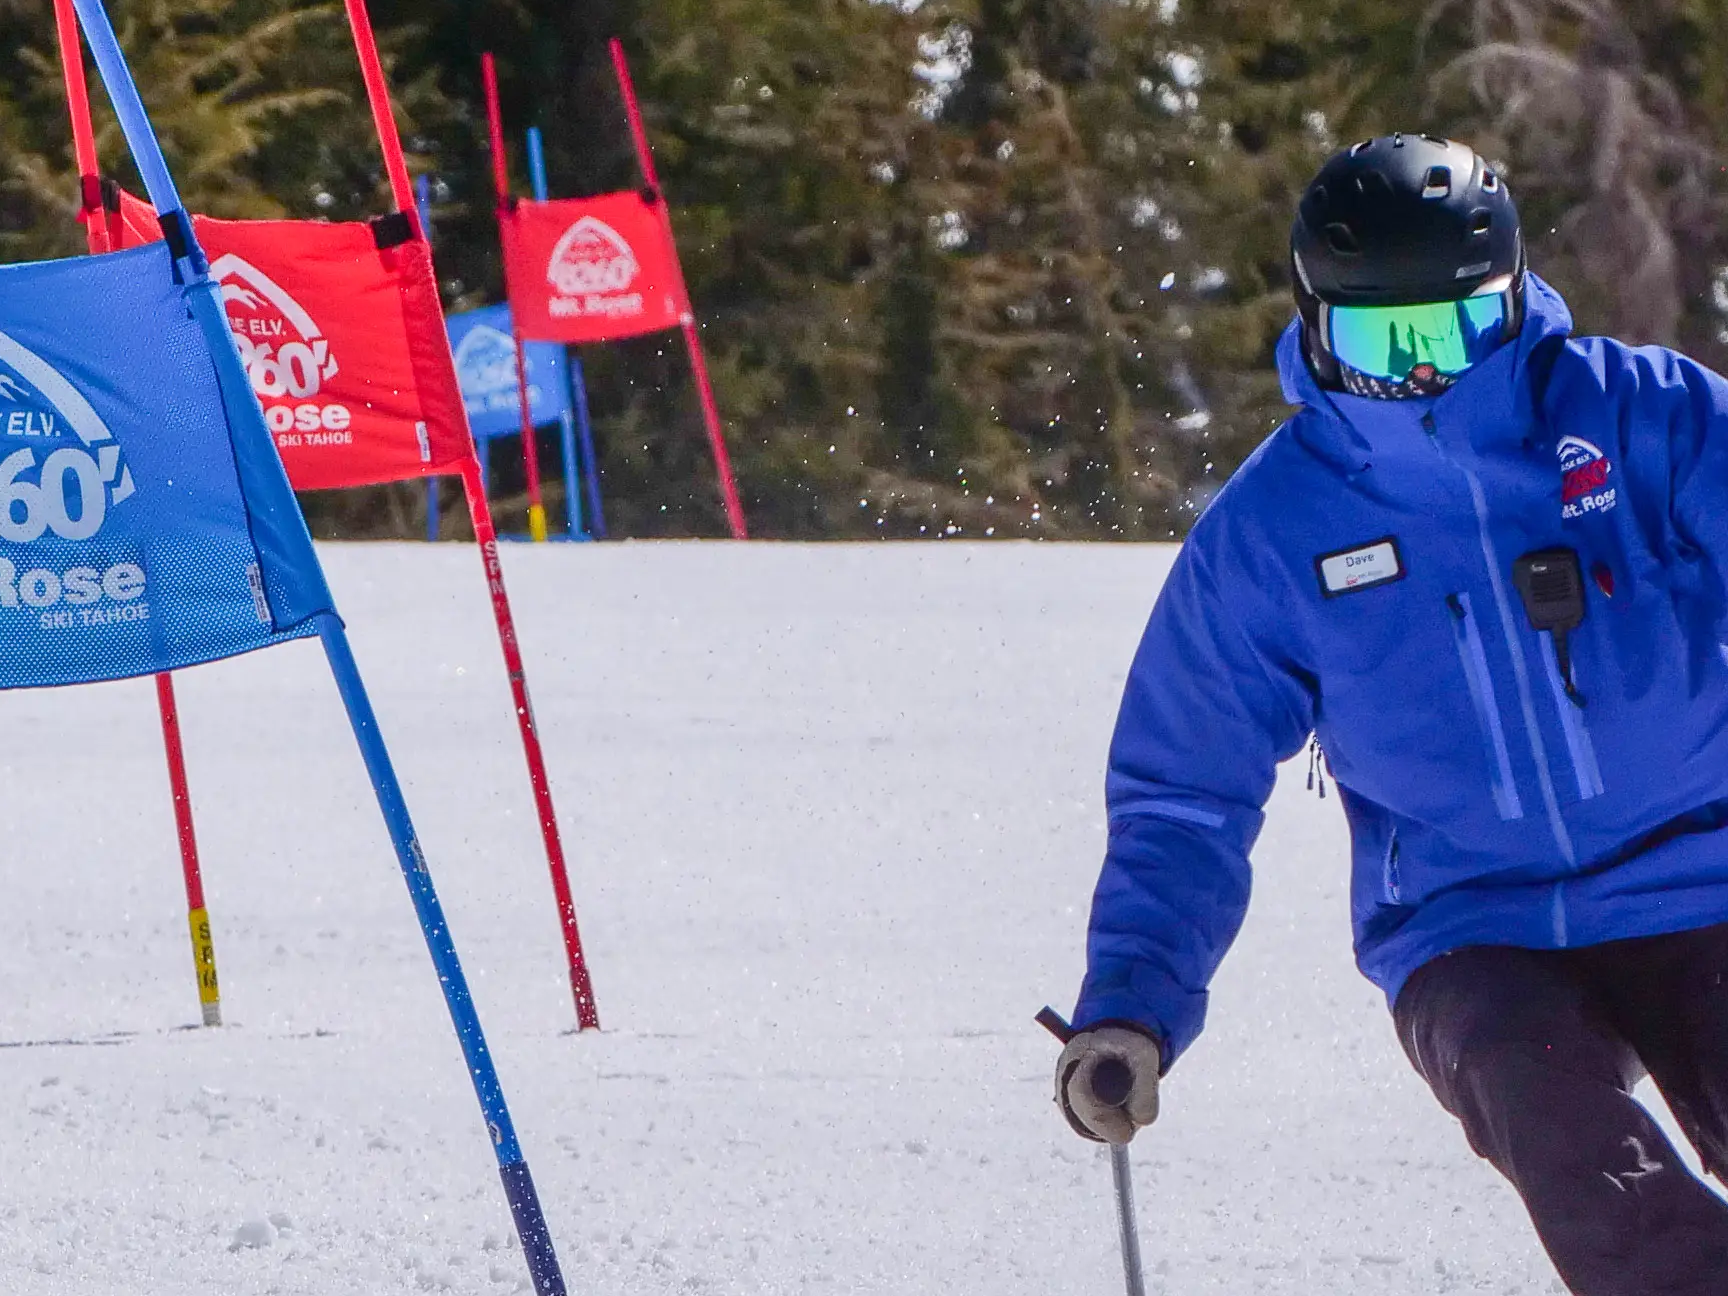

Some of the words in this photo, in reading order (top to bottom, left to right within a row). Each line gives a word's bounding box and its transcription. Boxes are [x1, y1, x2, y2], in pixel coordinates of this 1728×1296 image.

[249, 319, 287, 336] ELV.
[7, 412, 61, 437] ELV.
[279, 434, 302, 447] SKI
[306, 431, 353, 446] TAHOE
[1345, 554, 1375, 567] Dave
[39, 611, 74, 630] SKI
[78, 603, 150, 628] TAHOE
